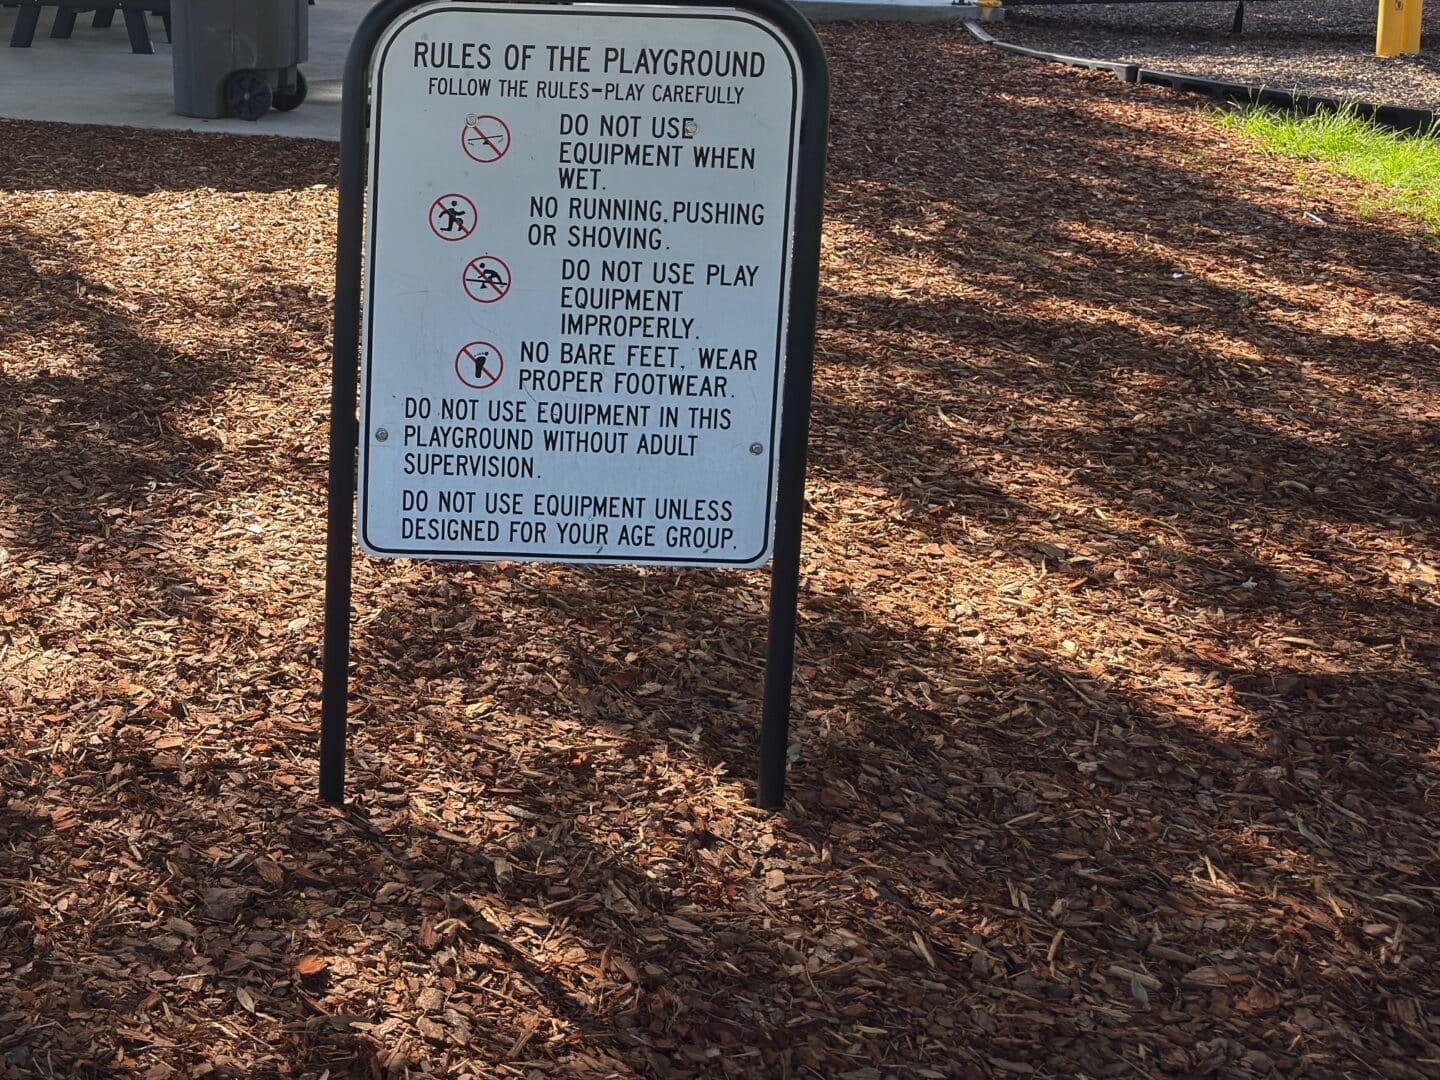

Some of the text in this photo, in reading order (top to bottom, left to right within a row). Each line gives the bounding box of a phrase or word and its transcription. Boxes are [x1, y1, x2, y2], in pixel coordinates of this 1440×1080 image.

[413, 41, 766, 78] RULES OF THE PLAYGROUND
[428, 77, 492, 97] FOLLOW
[498, 79, 529, 98] THE
[652, 83, 745, 105] CAREFULLY
[559, 113, 696, 140] DO NOT USE
[559, 141, 756, 170] EQUIPMENT WHEN
[558, 167, 606, 191] WET.
[529, 195, 559, 219] NO
[527, 223, 670, 251] OR SHOVING.
[561, 258, 760, 288] DO NOT USE PLAY
[560, 286, 684, 313] EQUIPMENT
[560, 312, 700, 340] IMPROPERLY.
[520, 340, 758, 371] NO BARE FEET, WEAR
[518, 368, 735, 399] PROPER FOOTWEAR.
[404, 396, 732, 431] DO NOT USE EQUIPMENT IN THIS
[403, 424, 699, 457] PLAYGROUND WITHOUT ADULT
[403, 452, 541, 479] SUPERVISION.
[402, 489, 733, 522] DO NOT USE EQUIPMENT UNLESS
[401, 517, 737, 550] DESIGNED FOR YOUR AGE GROUP.
